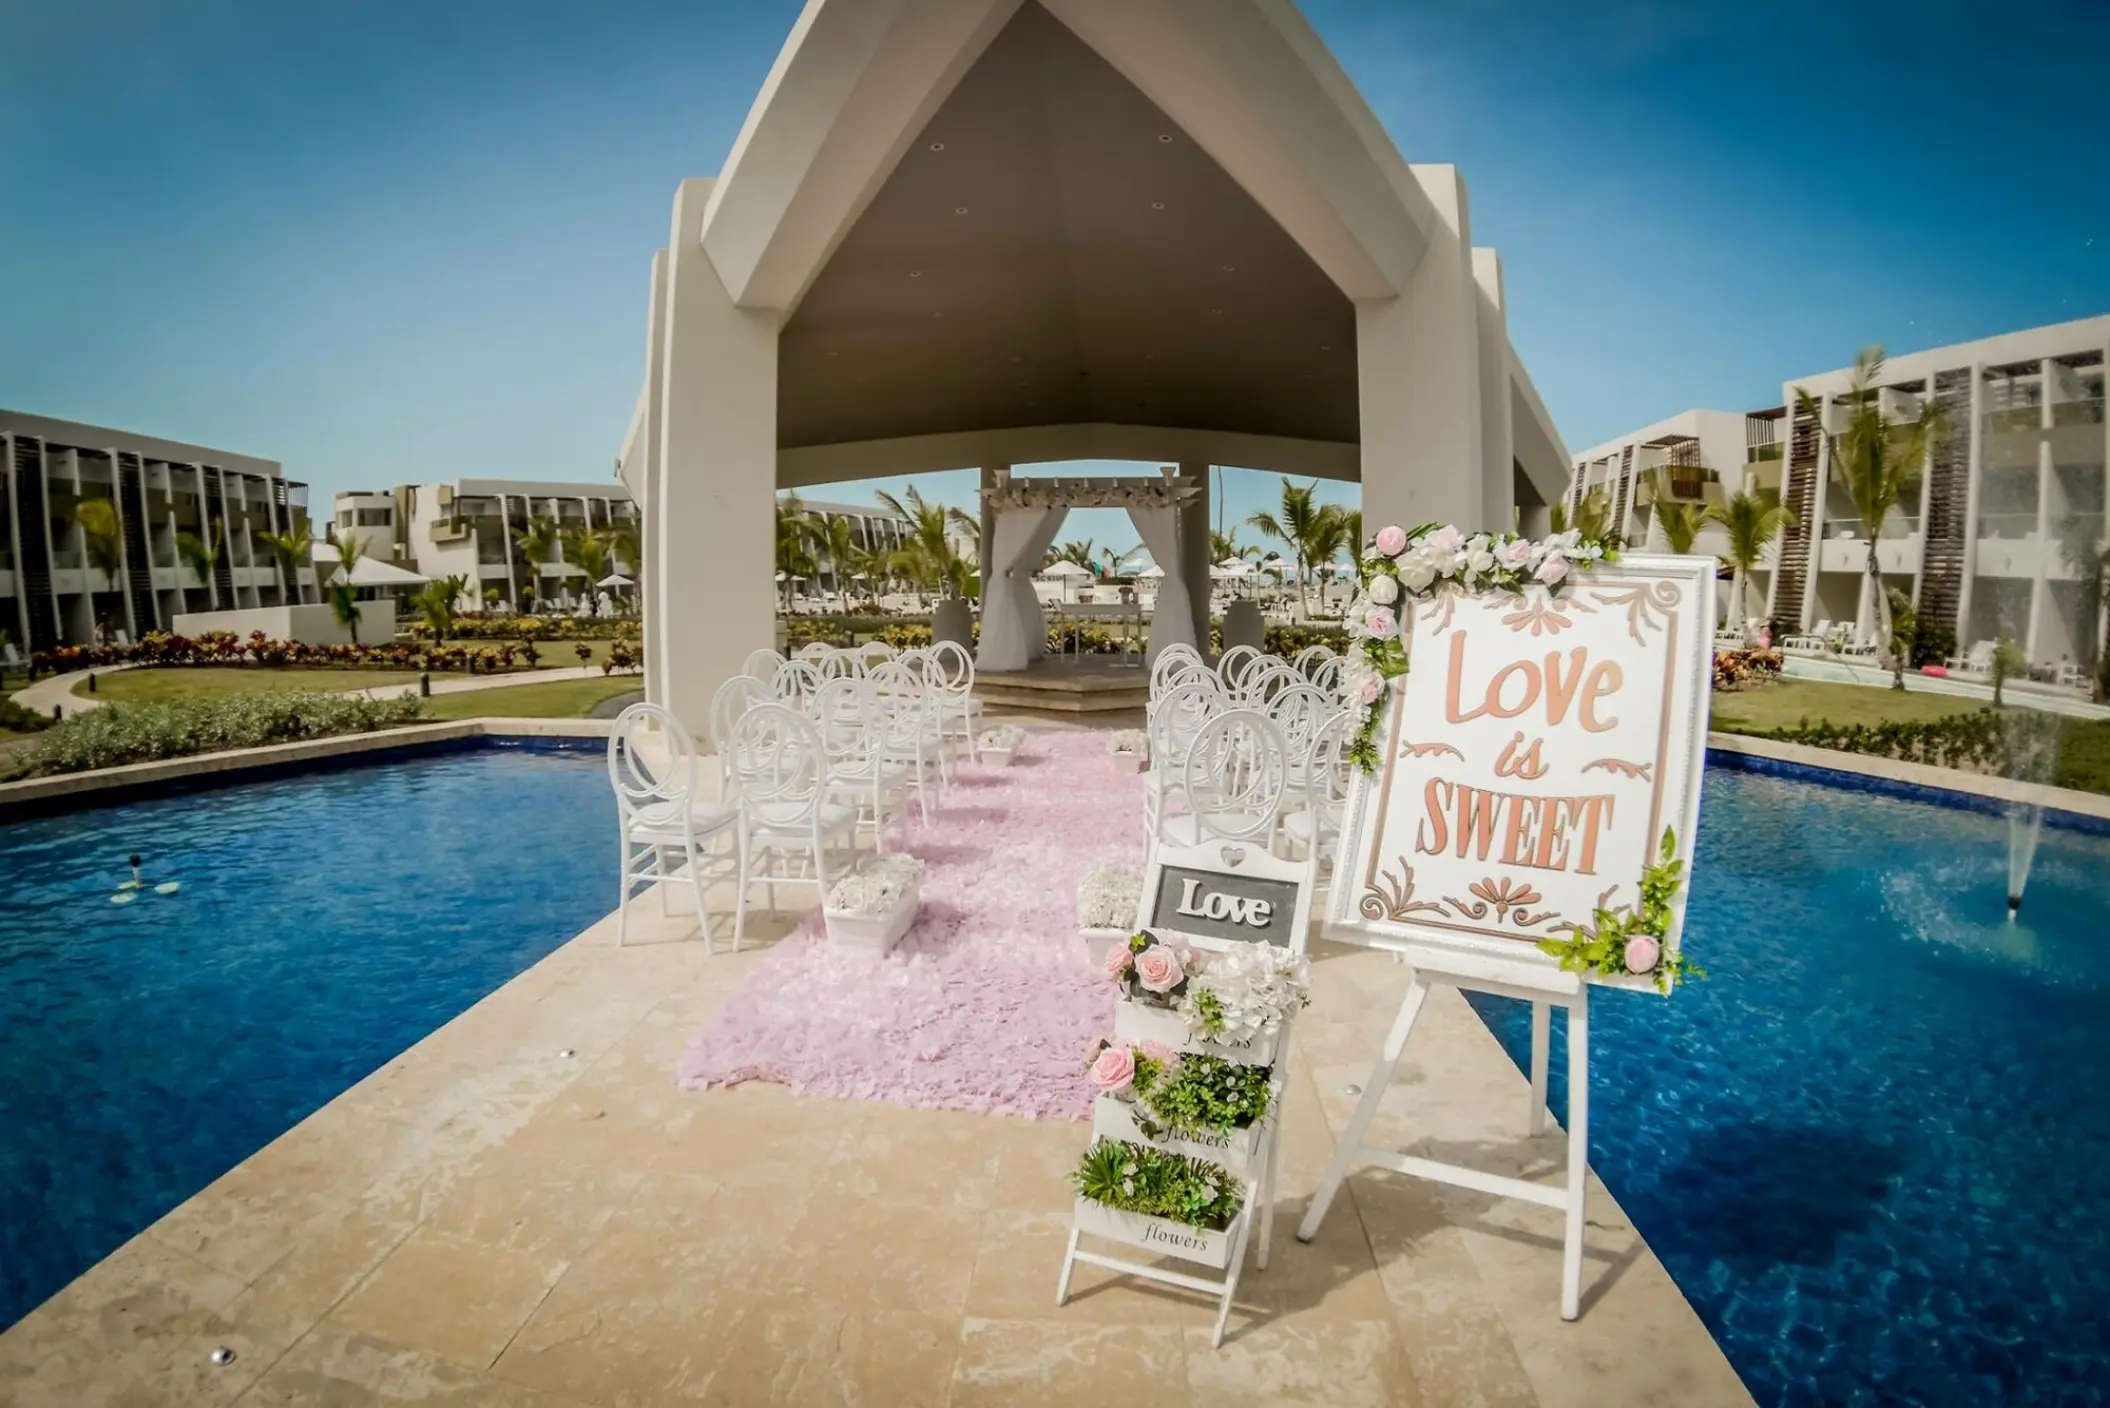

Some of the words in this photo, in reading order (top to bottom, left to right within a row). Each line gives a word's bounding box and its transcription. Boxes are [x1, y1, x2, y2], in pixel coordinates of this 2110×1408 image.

[1445, 629, 1624, 732] Love
[1494, 731, 1549, 779] is
[1415, 777, 1616, 875] SWEET
[1176, 878, 1272, 926] Love
[1140, 1222, 1208, 1251] flowers
